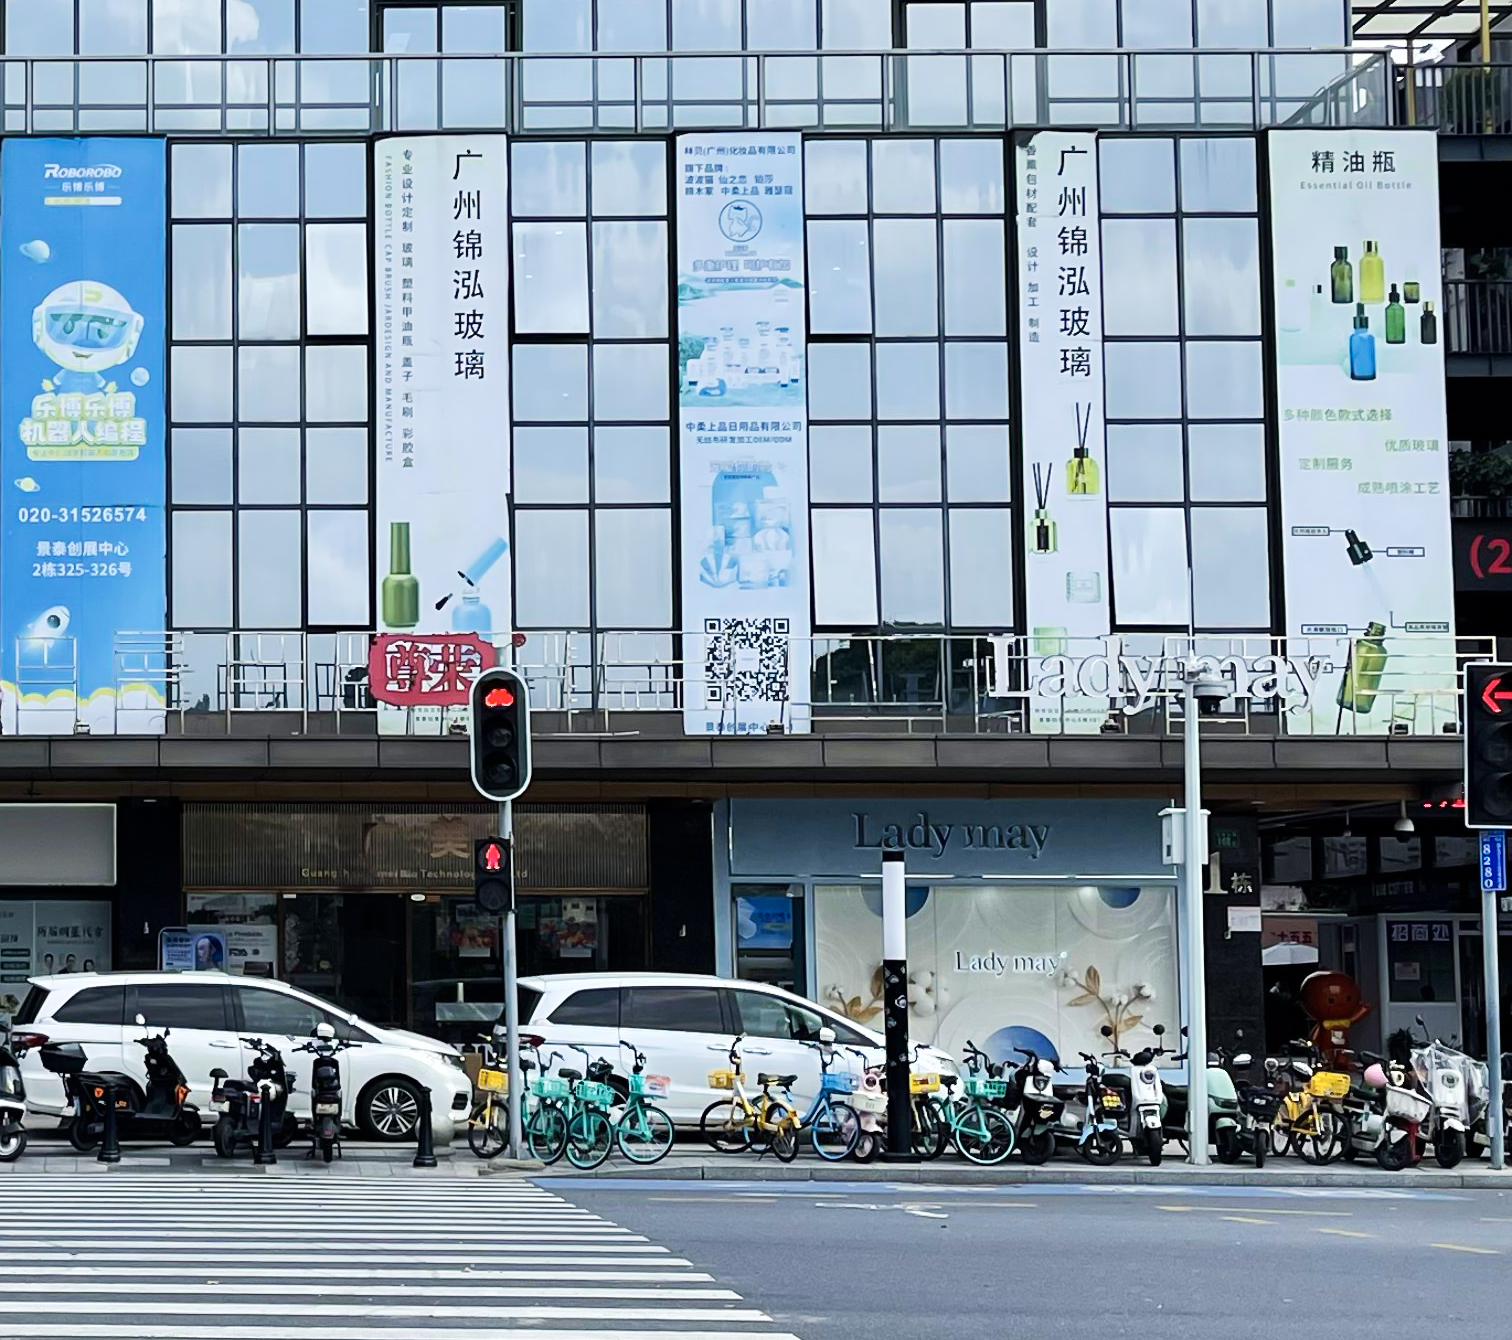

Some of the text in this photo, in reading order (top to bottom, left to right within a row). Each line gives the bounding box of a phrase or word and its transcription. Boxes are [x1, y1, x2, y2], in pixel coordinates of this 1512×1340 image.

[1311, 150, 1396, 174] 精油瓶
[1300, 181, 1412, 190] Essential Oil Bottle
[452, 148, 485, 380] 广州锦泓玻璃
[1057, 145, 1091, 377] 广州锦泓玻璃
[34, 395, 134, 420] 乐博乐博
[22, 419, 146, 445] 机器人编程
[18, 507, 147, 523] 020-31526574
[36, 541, 130, 557] 景泰创展中心
[32, 562, 133, 578] 2栋325-326号
[987, 633, 1164, 715] Lady
[852, 812, 1050, 859] Lady may
[954, 950, 1059, 977] Lady may
